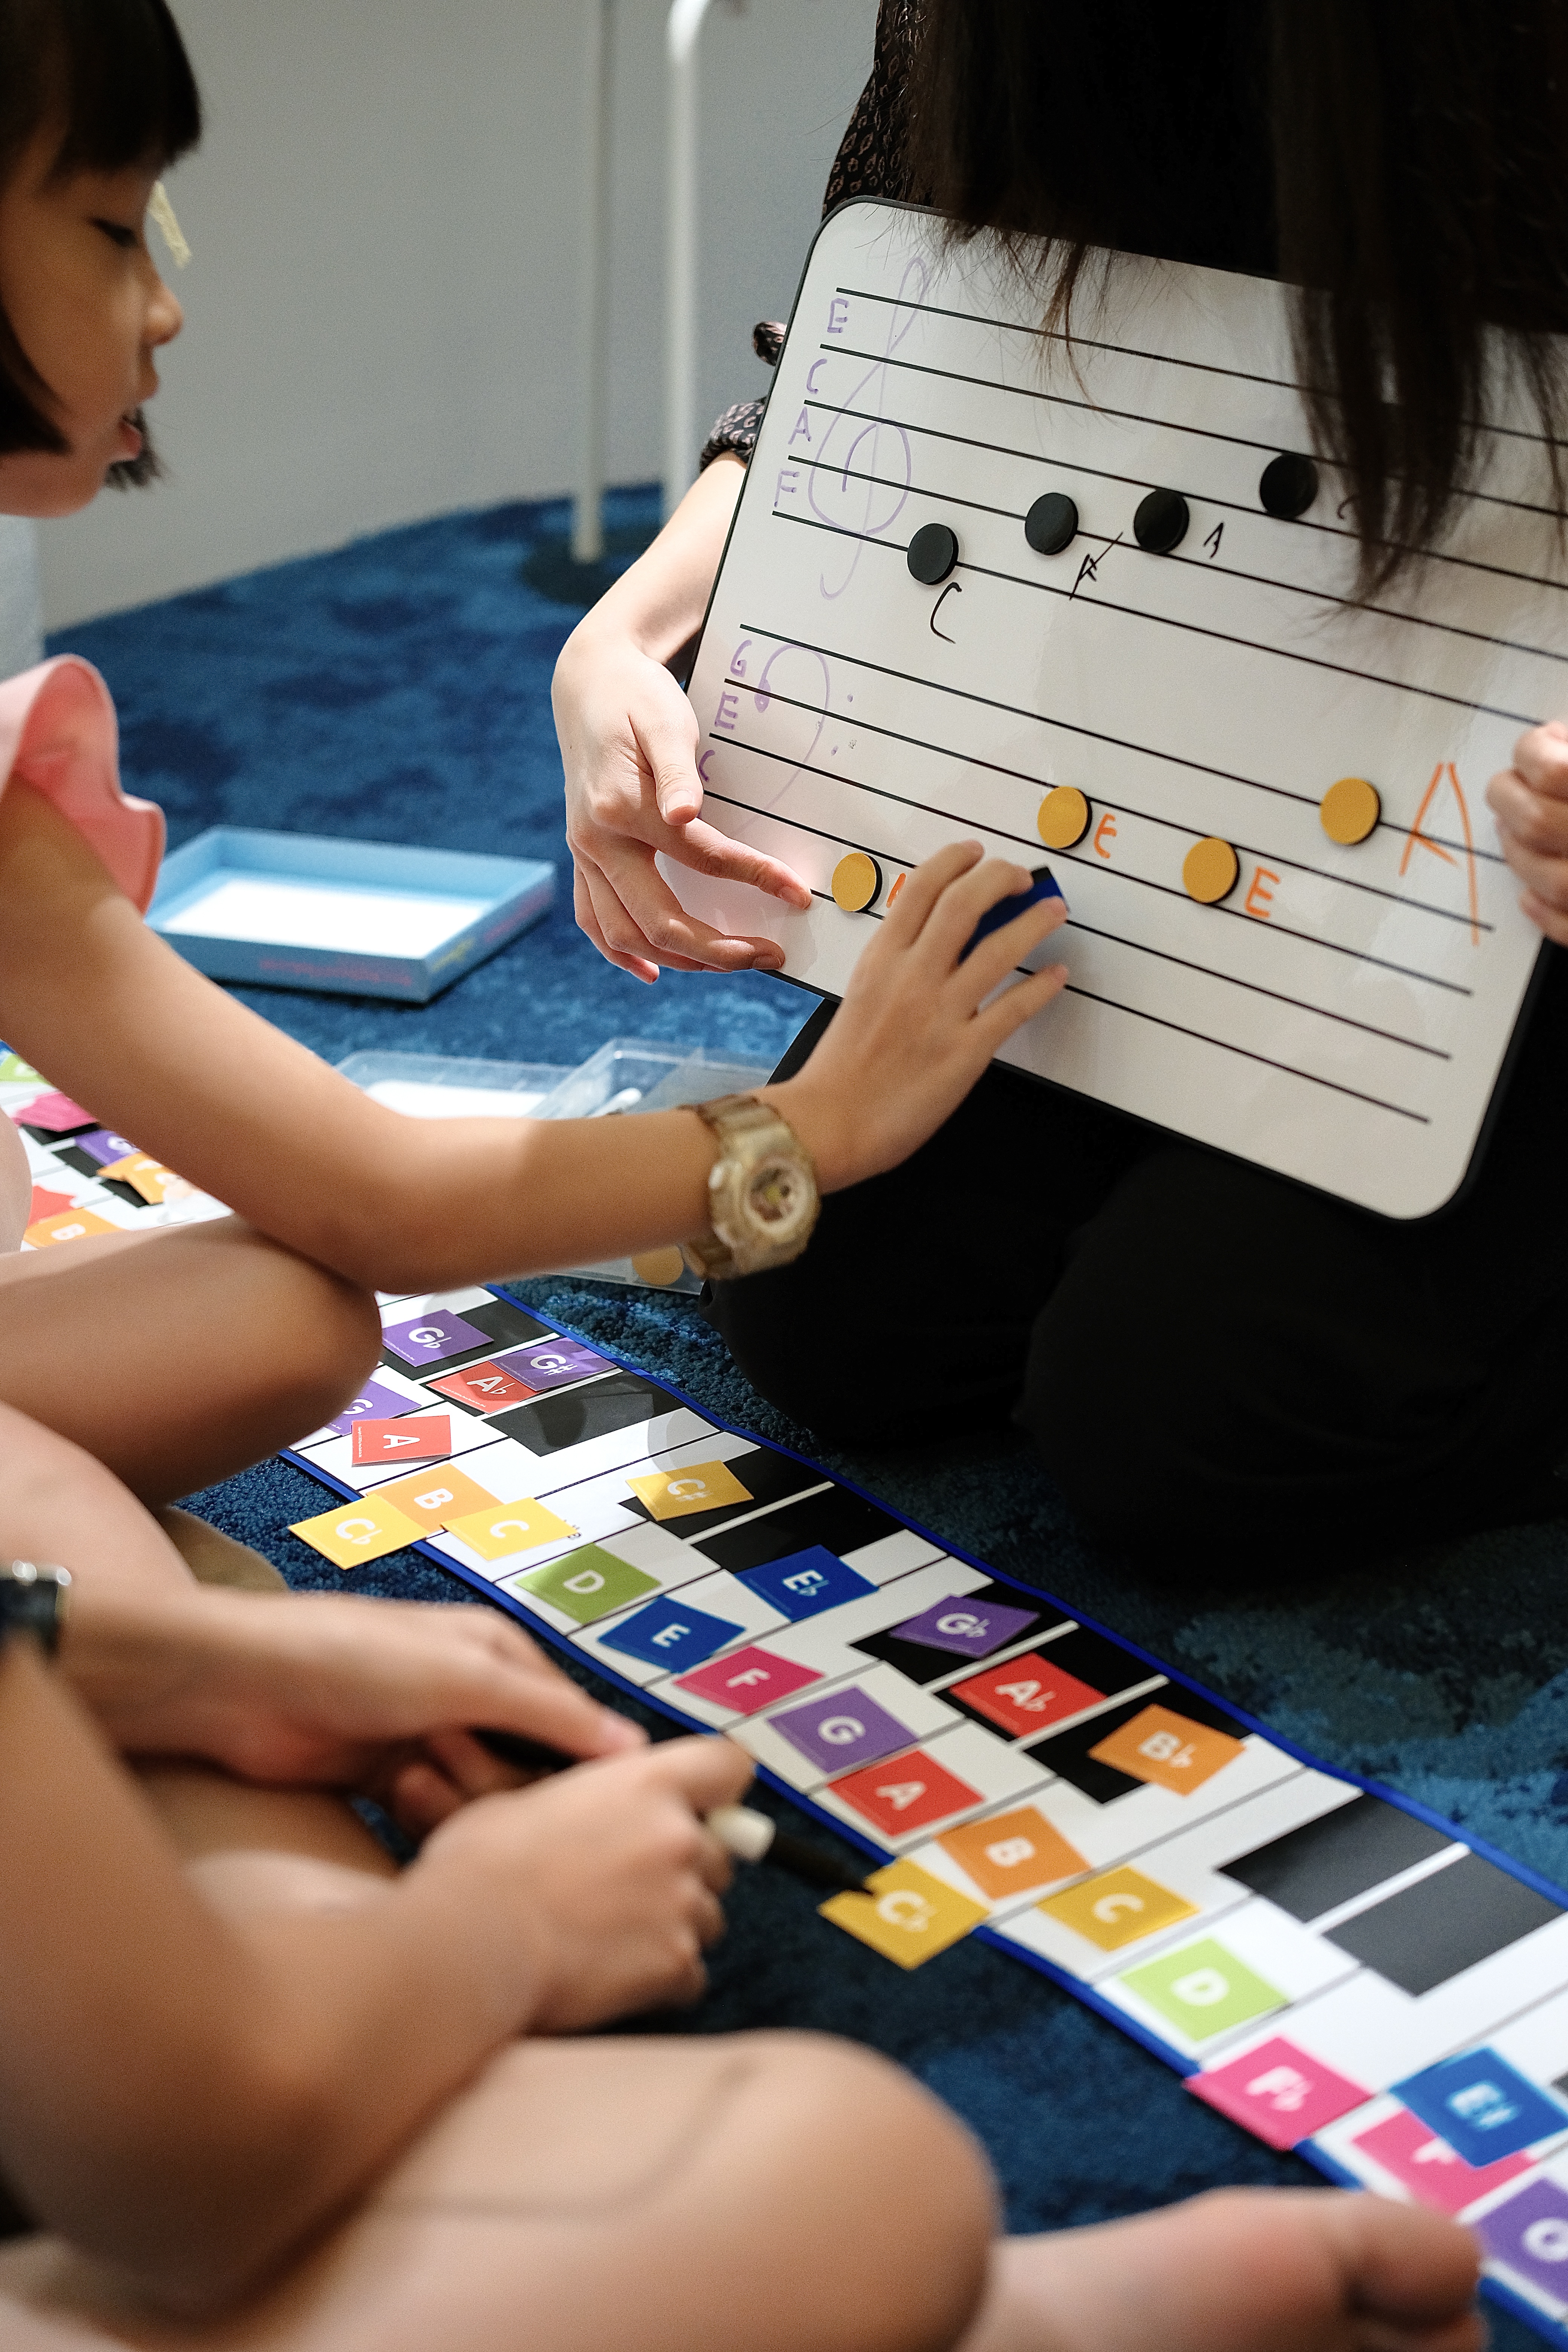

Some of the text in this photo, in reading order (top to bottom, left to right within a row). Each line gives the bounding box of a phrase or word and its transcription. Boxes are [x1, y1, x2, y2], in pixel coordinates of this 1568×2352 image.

[827, 298, 849, 334] E
[806, 358, 827, 395] C
[788, 407, 812, 446] A
[774, 469, 800, 507] F
[930, 582, 962, 644] C
[730, 640, 752, 677] G
[714, 691, 739, 729] E
[1093, 813, 1117, 859] E
[1398, 761, 1480, 947] A
[1245, 866, 1280, 917] E
[383, 1434, 420, 1449] A
[414, 1488, 453, 1509] B
[490, 1520, 529, 1538] C
[563, 1570, 605, 1594] D
[652, 1623, 691, 1648] E
[725, 1668, 771, 1688] F
[818, 1715, 865, 1745] G
[876, 1781, 926, 1810] A
[985, 1836, 1036, 1867] B
[1092, 1893, 1144, 1923] C
[1172, 1968, 1229, 2006] D
